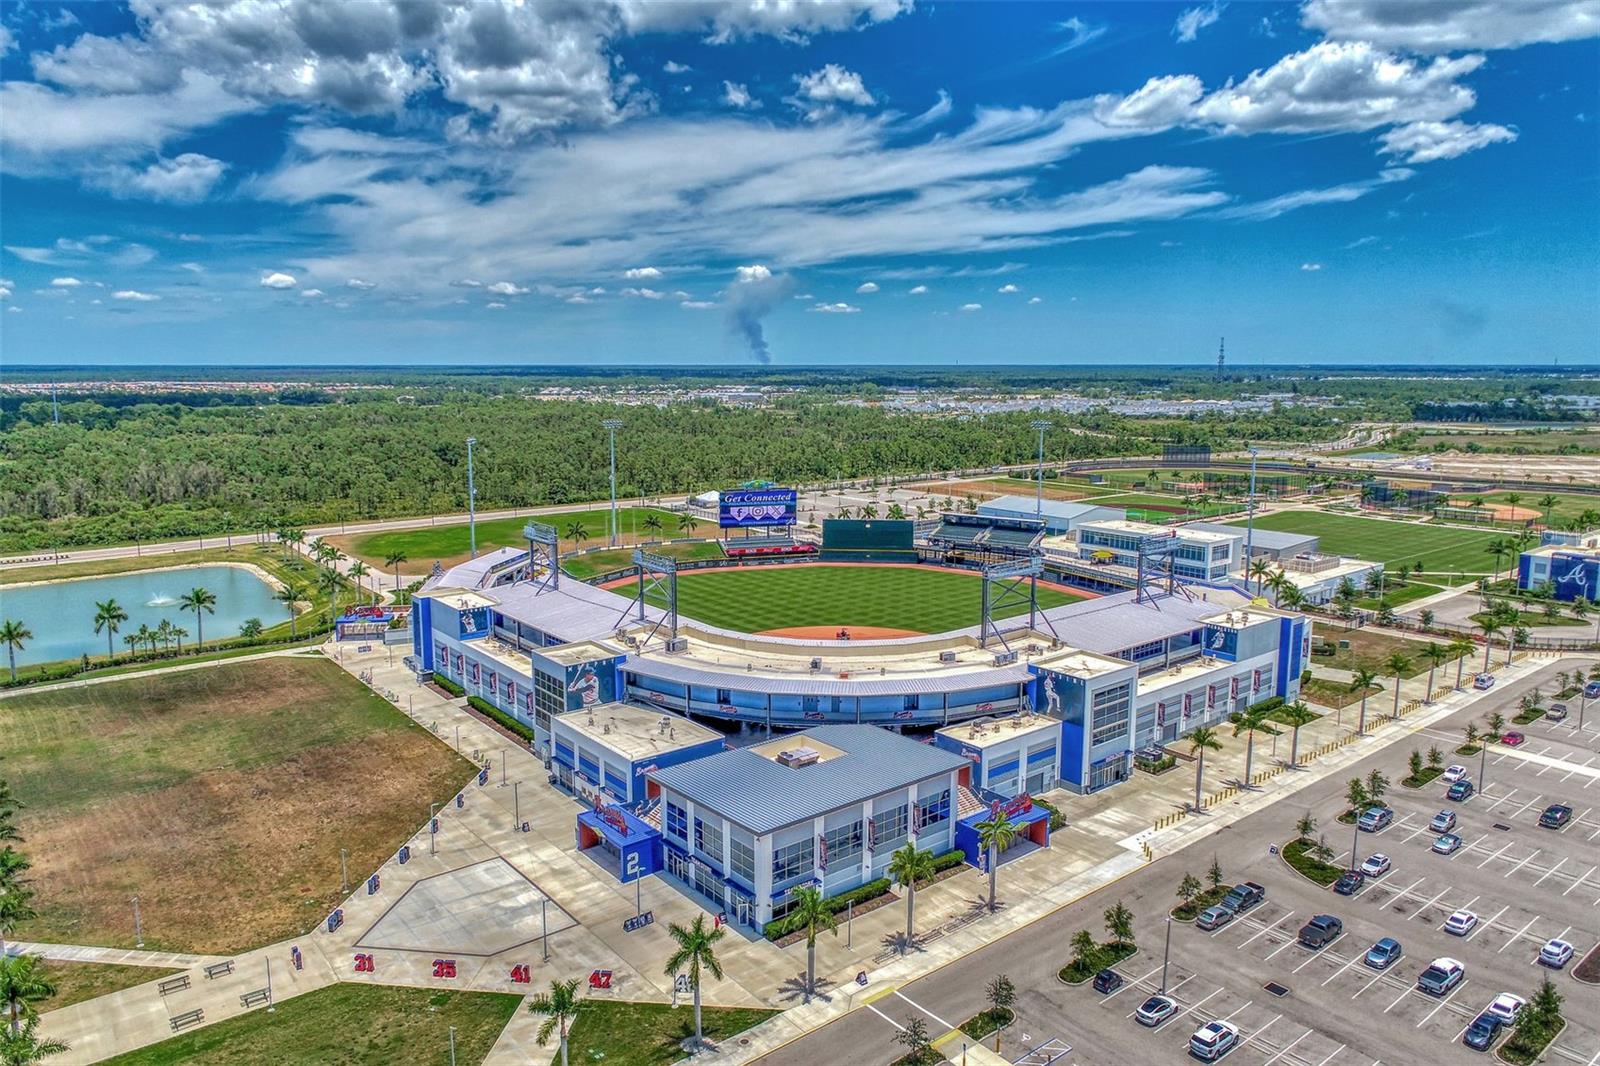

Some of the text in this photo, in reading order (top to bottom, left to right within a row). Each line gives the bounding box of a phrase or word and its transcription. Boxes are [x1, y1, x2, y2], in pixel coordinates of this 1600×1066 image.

[725, 495, 741, 503] Get
[744, 493, 792, 502] Connected
[1558, 563, 1586, 585] A
[626, 851, 639, 876] 2
[353, 953, 375, 973] 31
[431, 959, 457, 978] 35
[510, 964, 532, 984] 41
[589, 970, 613, 989] 47
